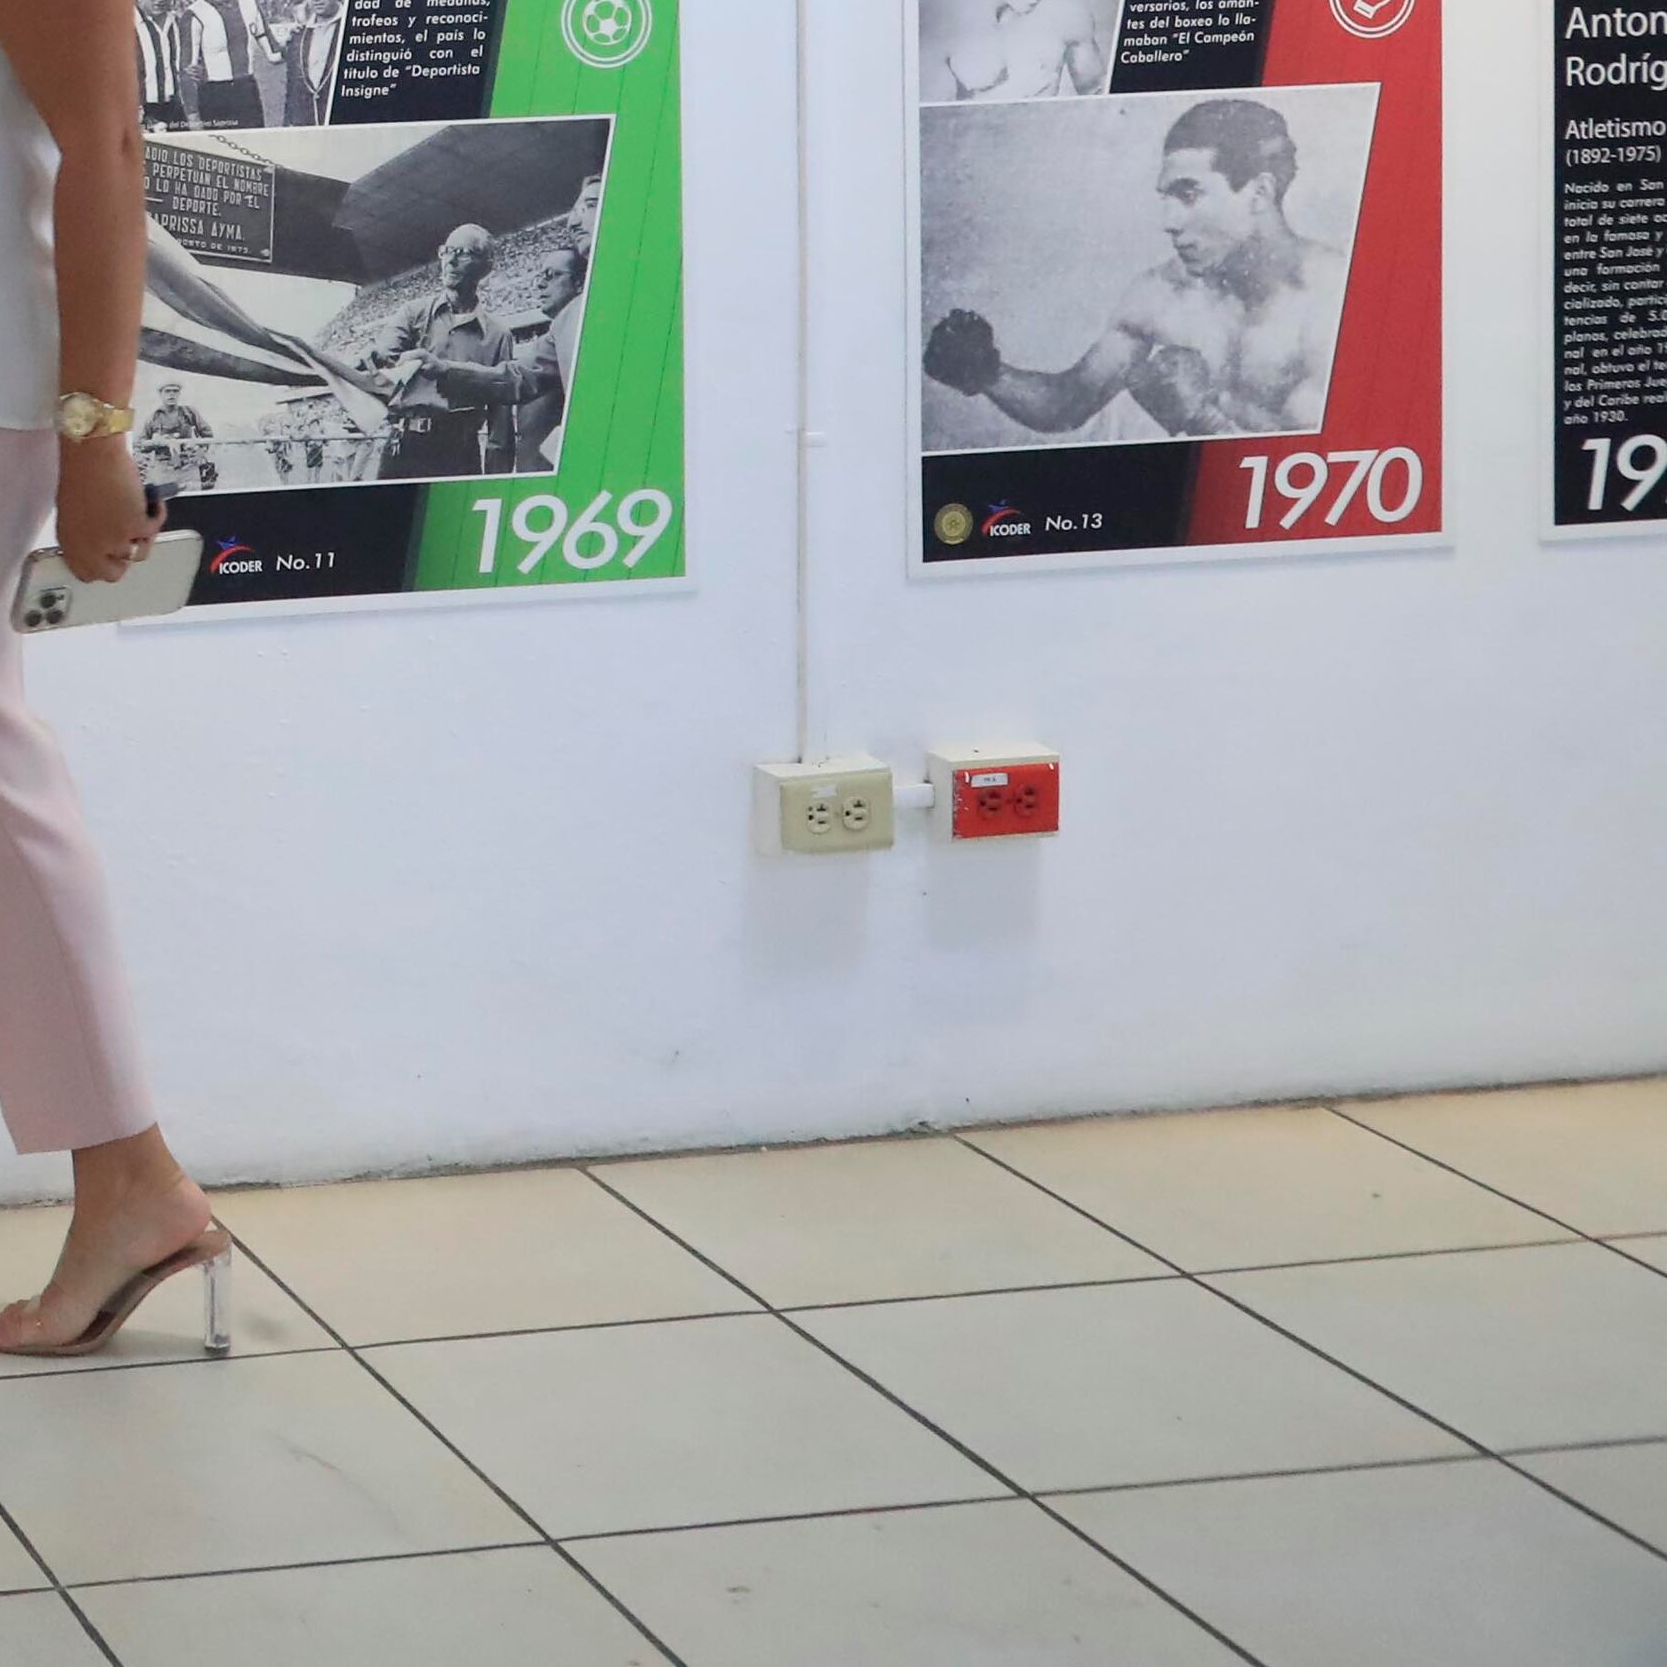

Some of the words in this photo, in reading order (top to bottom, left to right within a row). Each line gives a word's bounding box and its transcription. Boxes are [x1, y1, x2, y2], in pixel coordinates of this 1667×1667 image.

[1565, 118, 1666, 140] Atletismo
[1566, 146, 1661, 167] (1892-1975)
[216, 175, 229, 189] EL
[1582, 434, 1667, 511] 19
[1240, 447, 1422, 529] 1970
[473, 489, 672, 574] 1969
[989, 522, 1031, 536] ICODER
[1046, 513, 1102, 531] No.13
[219, 560, 262, 574] ICODER
[277, 552, 334, 571] No.11
